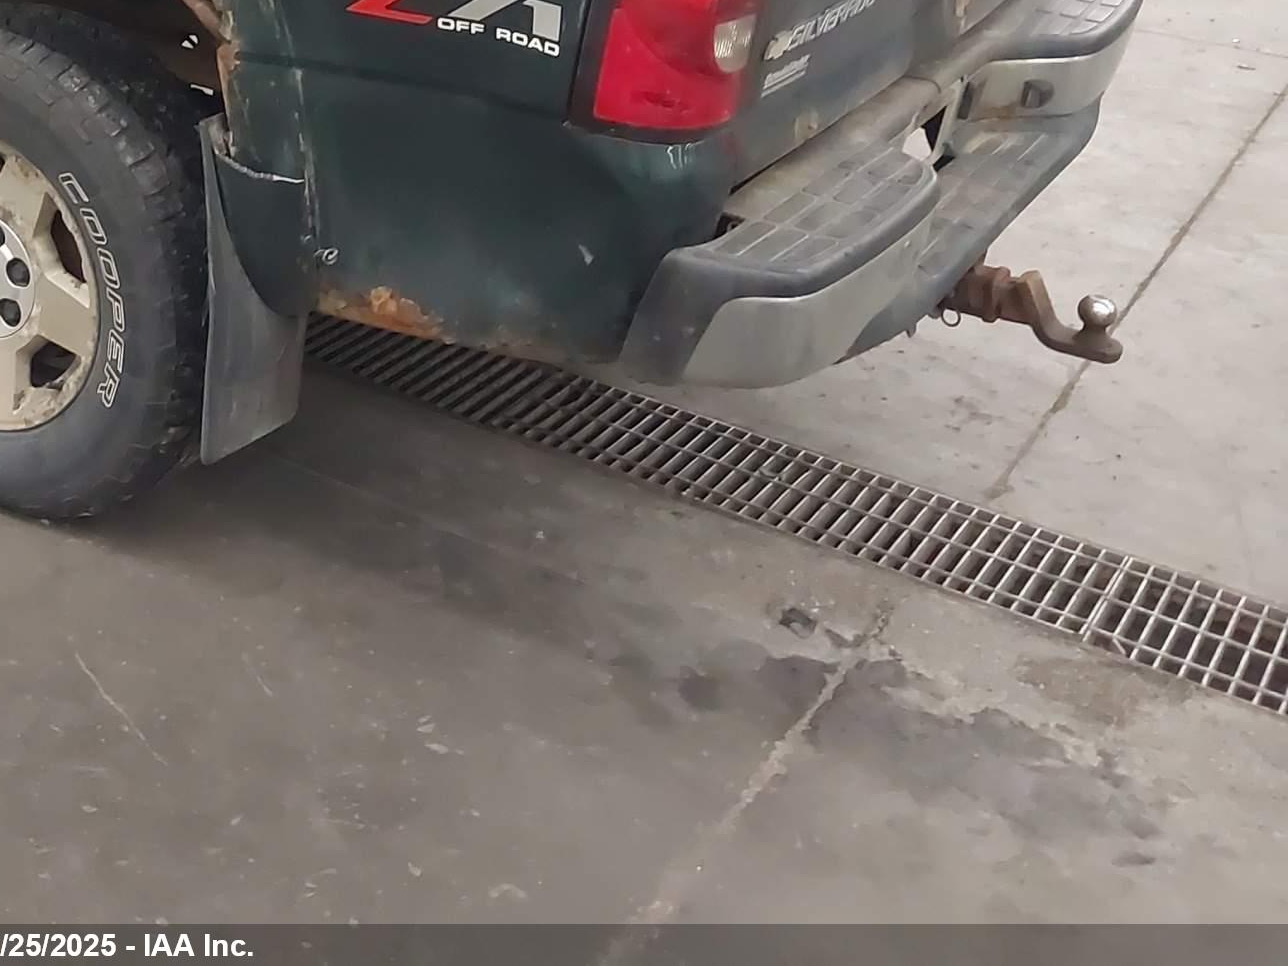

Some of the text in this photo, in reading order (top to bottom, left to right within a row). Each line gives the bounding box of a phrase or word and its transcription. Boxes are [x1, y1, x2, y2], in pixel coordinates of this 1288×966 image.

[436, 17, 560, 57] OFF ROAD
[57, 171, 126, 409] COOPER
